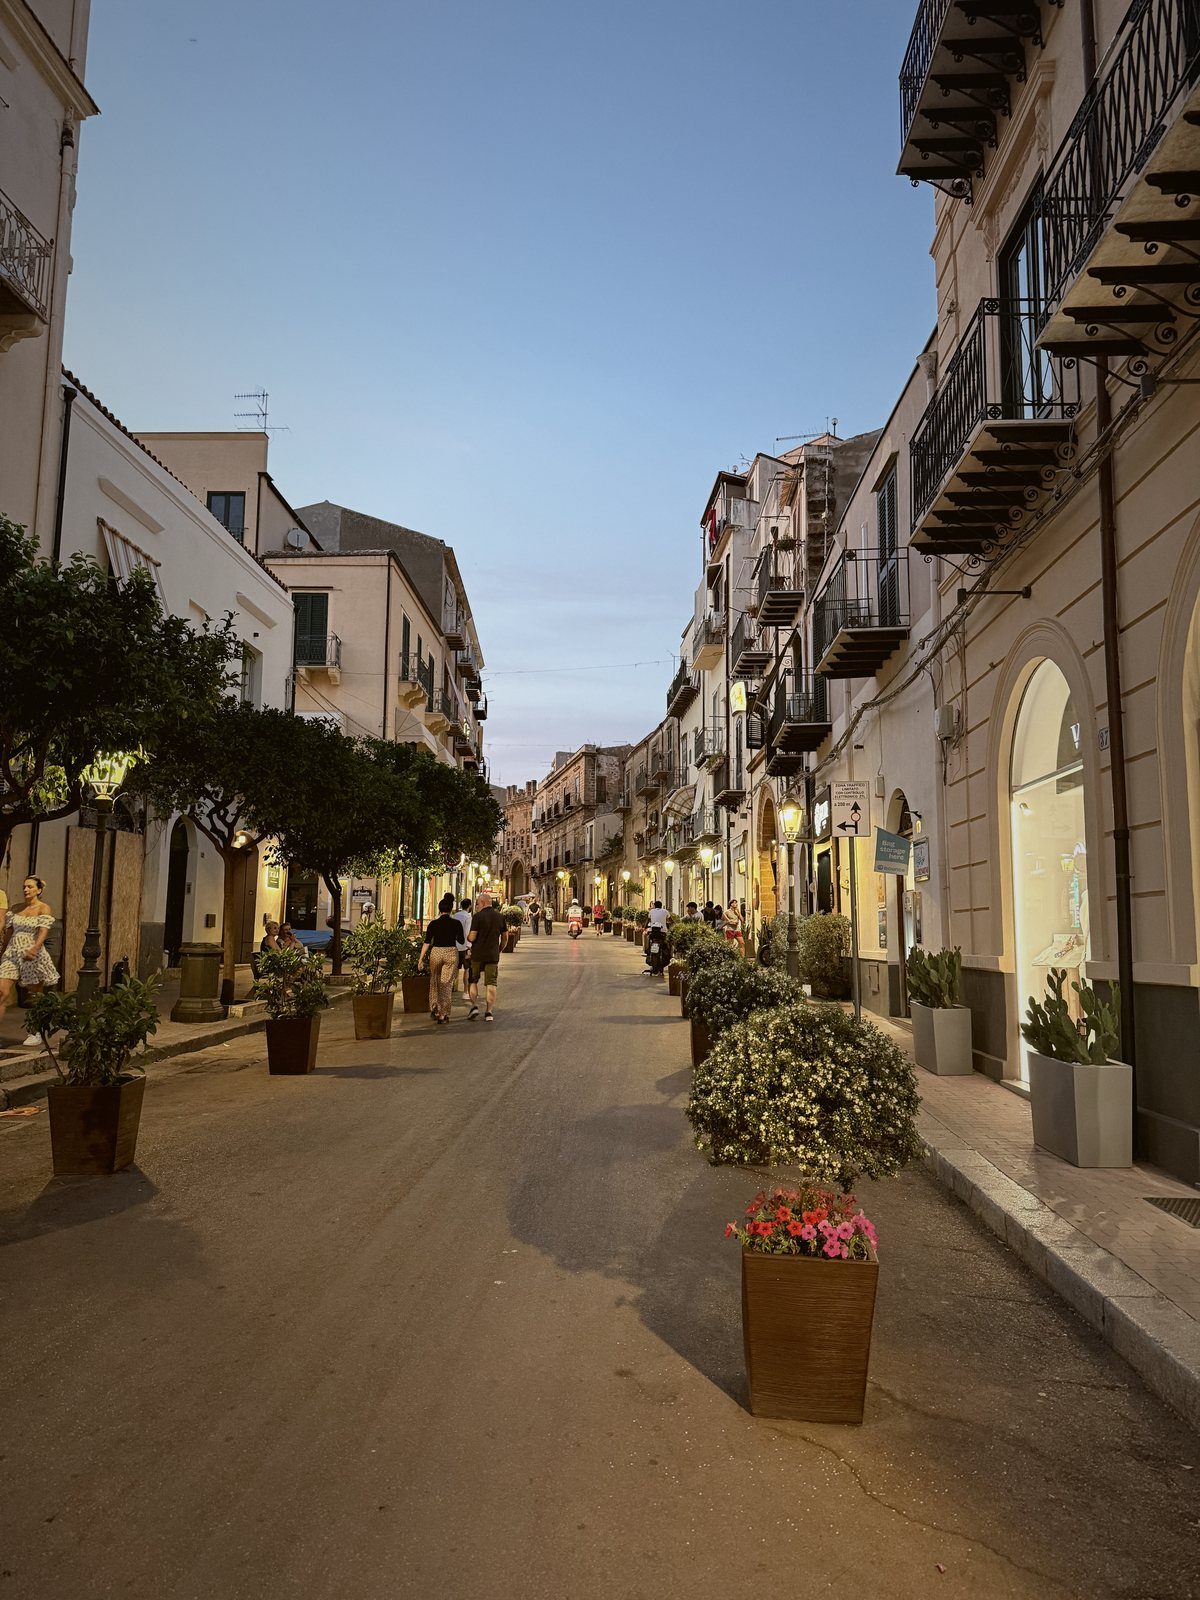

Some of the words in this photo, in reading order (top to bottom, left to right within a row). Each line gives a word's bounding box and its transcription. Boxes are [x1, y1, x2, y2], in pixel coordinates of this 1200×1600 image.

[882, 840, 895, 848] Bag
[879, 847, 906, 855] storage
[888, 853, 904, 861] here
